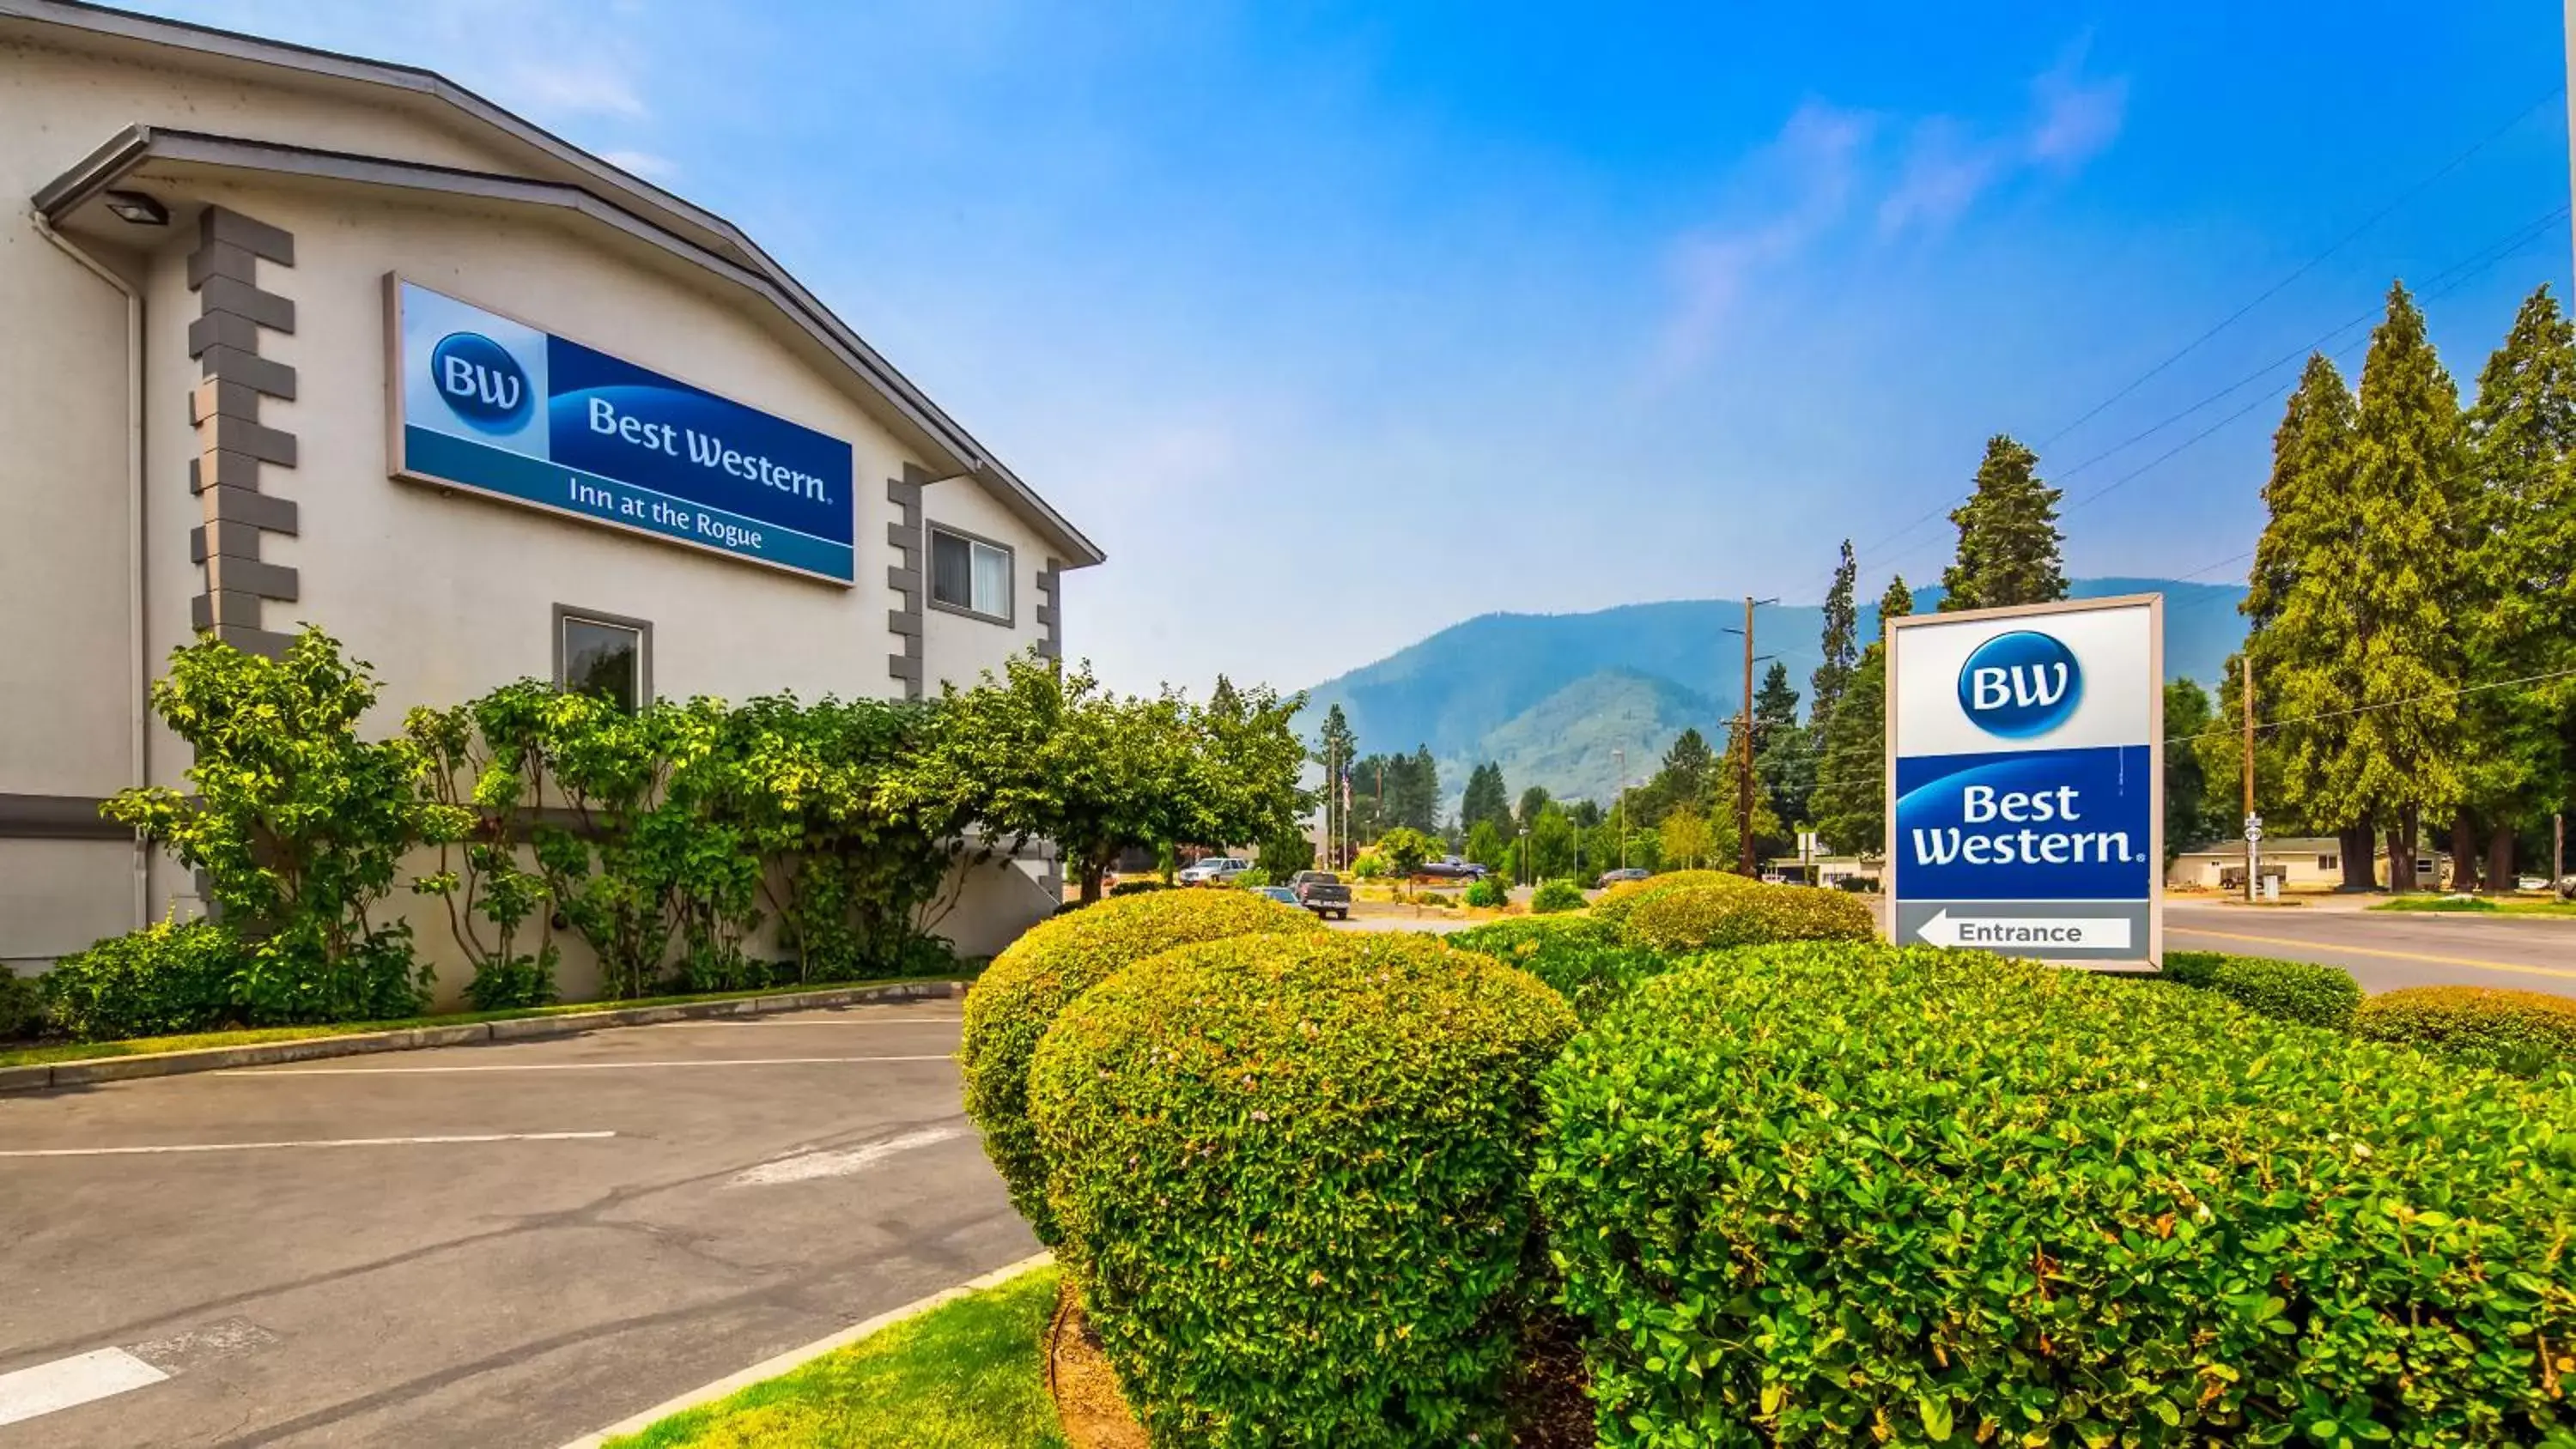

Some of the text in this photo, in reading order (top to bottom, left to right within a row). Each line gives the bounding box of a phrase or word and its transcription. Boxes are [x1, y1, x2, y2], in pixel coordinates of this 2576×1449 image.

[444, 355, 519, 410] BW
[589, 397, 678, 458] Best
[569, 477, 762, 549] Inn at the Rogue
[1973, 661, 2069, 712] BW
[1963, 785, 2081, 824] Best
[1958, 922, 2083, 943] Entrance
